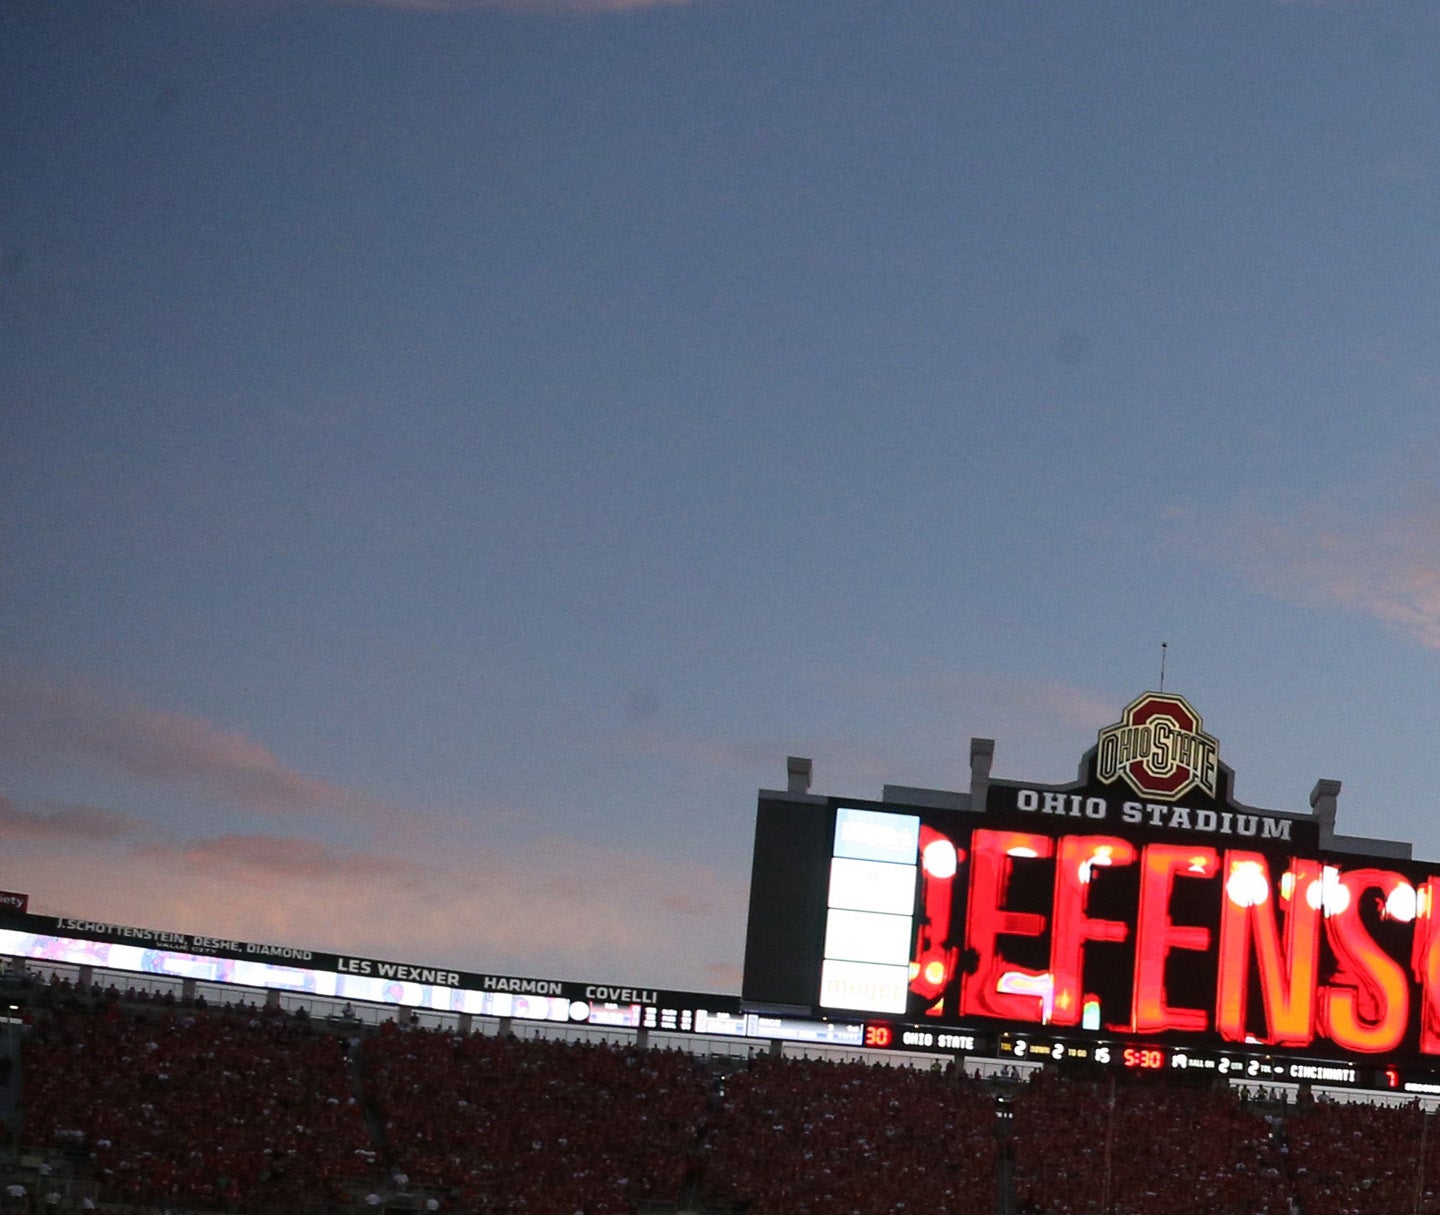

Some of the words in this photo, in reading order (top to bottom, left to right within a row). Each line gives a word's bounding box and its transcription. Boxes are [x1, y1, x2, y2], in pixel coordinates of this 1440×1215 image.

[1017, 789, 1107, 819] OHIO
[1122, 801, 1293, 841] STADIUM
[193, 935, 242, 954] DESHE,
[247, 943, 313, 961] DIAMOND
[337, 957, 372, 974] LES
[377, 962, 461, 986] WEXNER
[484, 976, 563, 996] HARMON
[586, 985, 657, 1003] COVELLI
[866, 1026, 890, 1045] 30
[903, 1031, 933, 1047] OHIO
[938, 1033, 975, 1050] STATE
[1014, 1040, 1026, 1056] 2
[1052, 1044, 1064, 1059] 2
[1095, 1048, 1110, 1064] 15
[1124, 1049, 1163, 1069] 5:30
[1218, 1057, 1229, 1073] 2
[1247, 1060, 1259, 1075] 2
[1290, 1063, 1355, 1082] CINCINNATI
